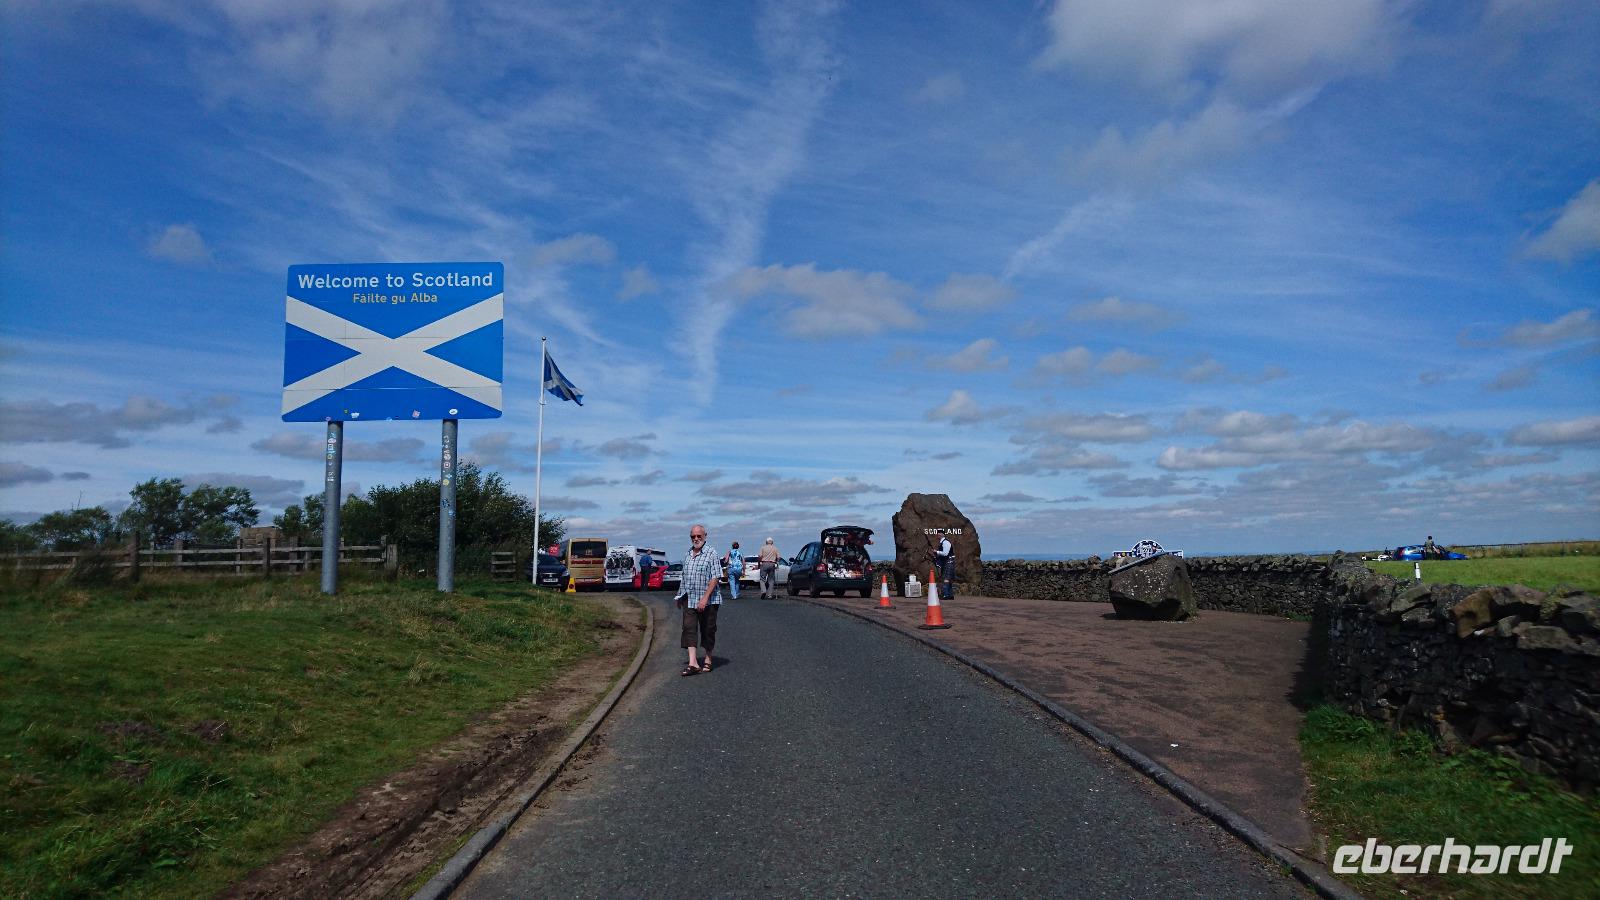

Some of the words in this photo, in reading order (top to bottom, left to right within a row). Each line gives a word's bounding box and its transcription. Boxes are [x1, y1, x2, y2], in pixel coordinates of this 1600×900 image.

[297, 273, 379, 289] Welcome
[385, 273, 405, 288] to
[412, 272, 493, 288] Scotland
[391, 294, 406, 305] gu
[410, 292, 438, 304] Alba
